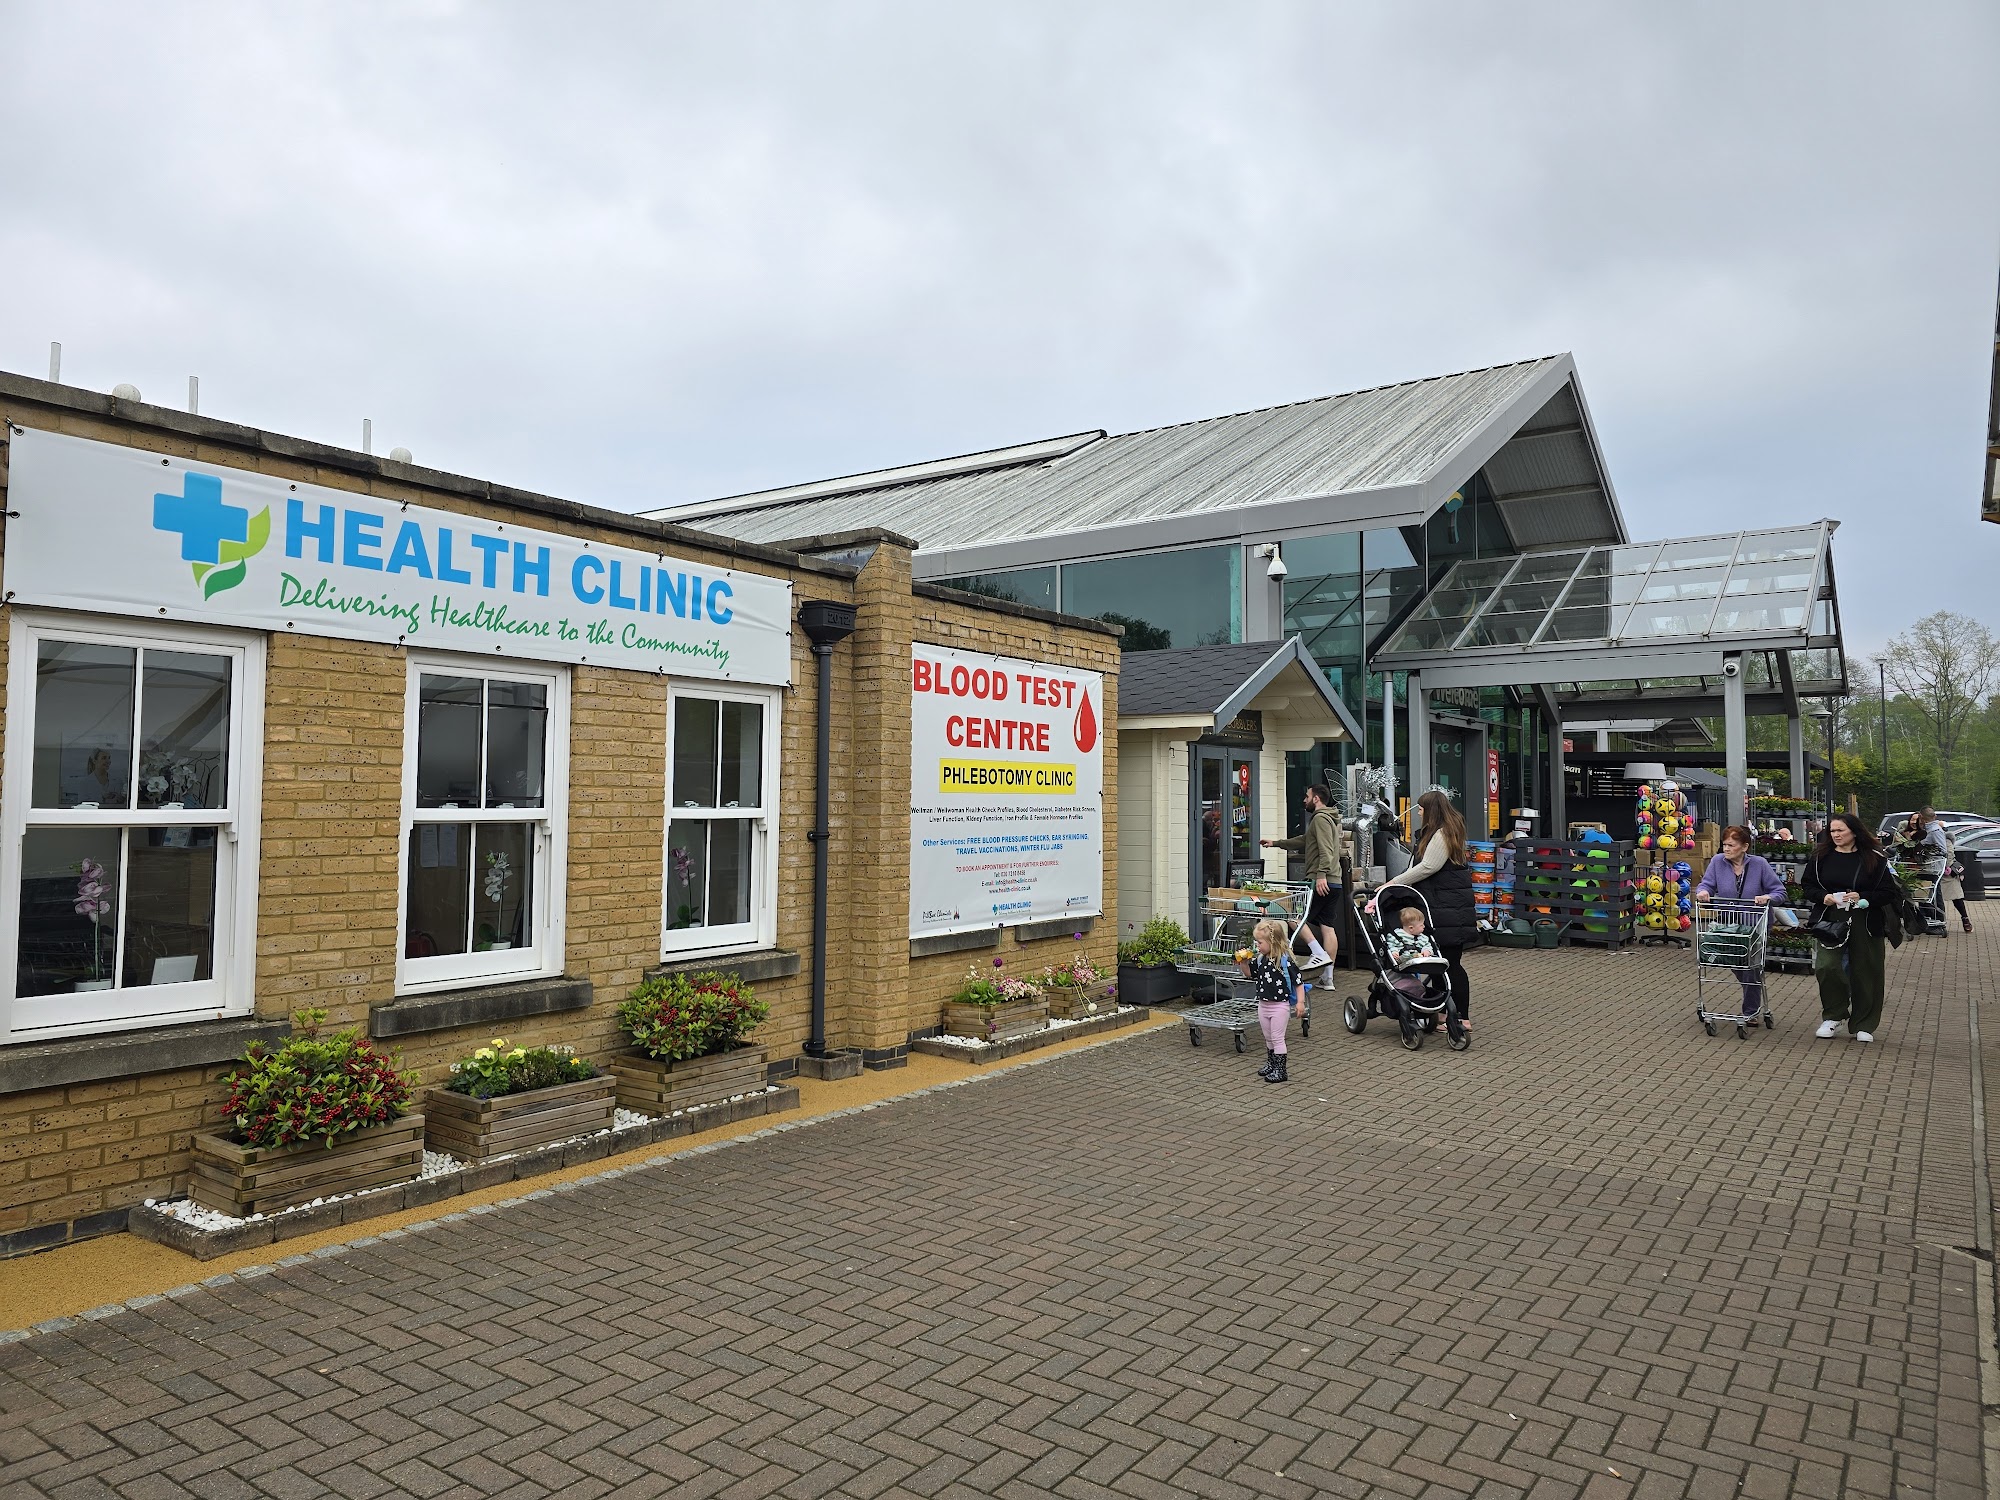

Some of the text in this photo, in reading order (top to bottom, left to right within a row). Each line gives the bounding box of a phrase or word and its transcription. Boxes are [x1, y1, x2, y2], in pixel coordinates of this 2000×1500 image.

[285, 499, 734, 625] HEALTH CLINIC
[280, 571, 730, 669] Delivering Healthcare to the Community
[828, 611, 851, 626] 2012
[913, 659, 1076, 709] BLOOD TEST
[946, 715, 1050, 752] CENTRE
[943, 766, 1073, 787] PHLEBOTOMY CLINIC
[940, 838, 966, 846] Services:
[978, 846, 1020, 854] VACCINATIONS,
[998, 901, 1032, 911] HEALTH CLINIC
